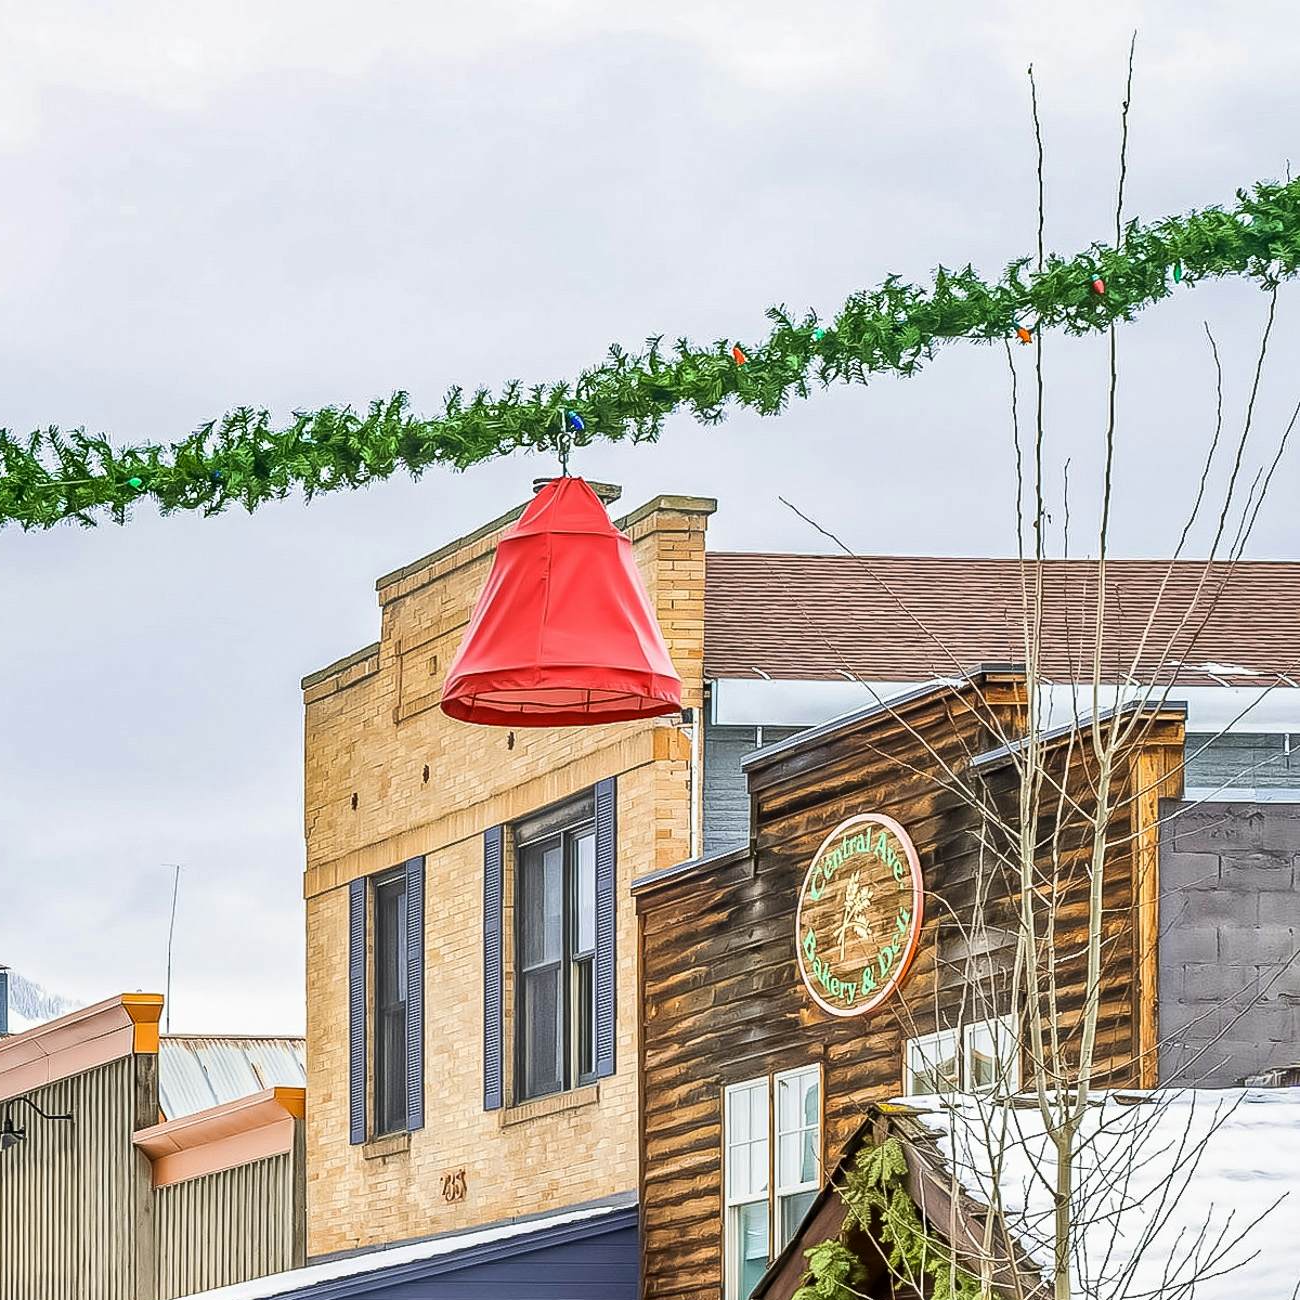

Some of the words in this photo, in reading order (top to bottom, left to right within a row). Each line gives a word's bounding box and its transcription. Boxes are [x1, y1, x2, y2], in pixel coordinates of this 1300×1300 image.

[810, 827, 872, 902] Central
[803, 927, 857, 1004] Bakery
[861, 965, 877, 997] &
[877, 906, 911, 978] Deli
